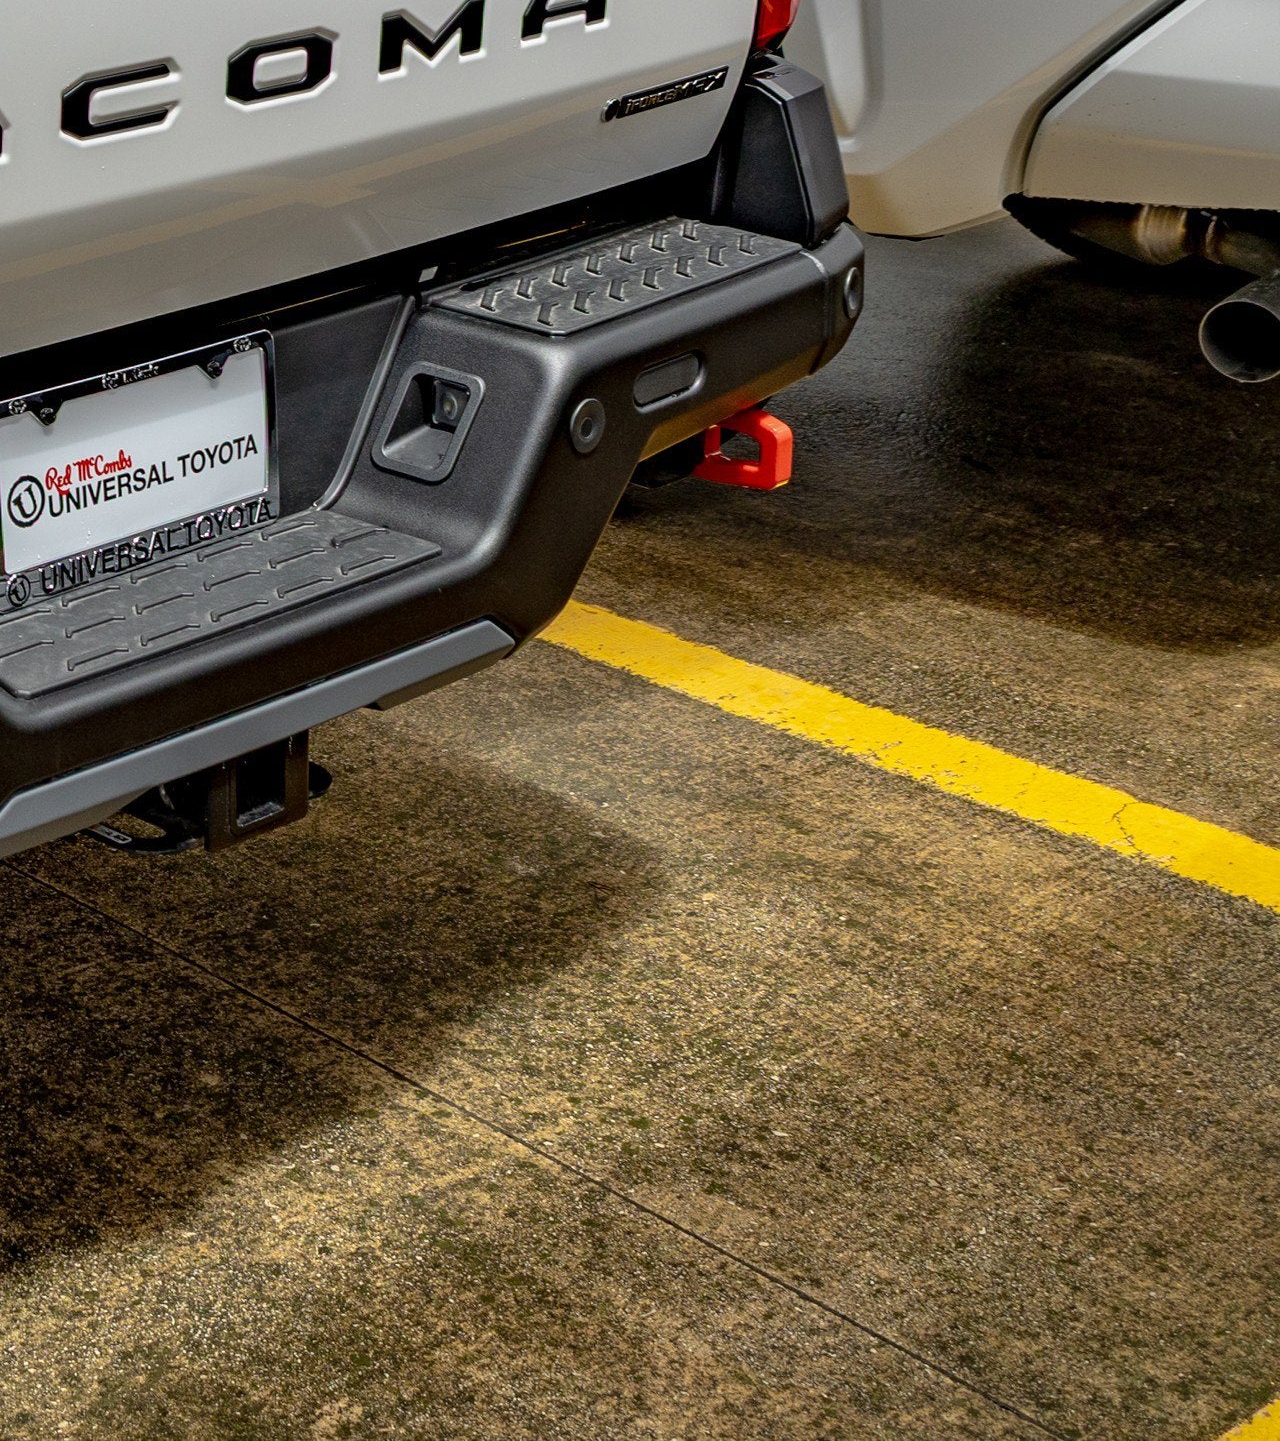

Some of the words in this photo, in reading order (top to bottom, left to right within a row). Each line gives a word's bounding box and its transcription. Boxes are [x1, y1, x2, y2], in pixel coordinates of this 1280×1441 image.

[46, 467, 72, 494] Red
[74, 449, 132, 479] McCombs
[48, 461, 174, 518] UNIVERSAL
[178, 434, 258, 477] TOYOTA
[41, 528, 181, 593] UNIVERSAL
[182, 498, 276, 548] TOYOTA
